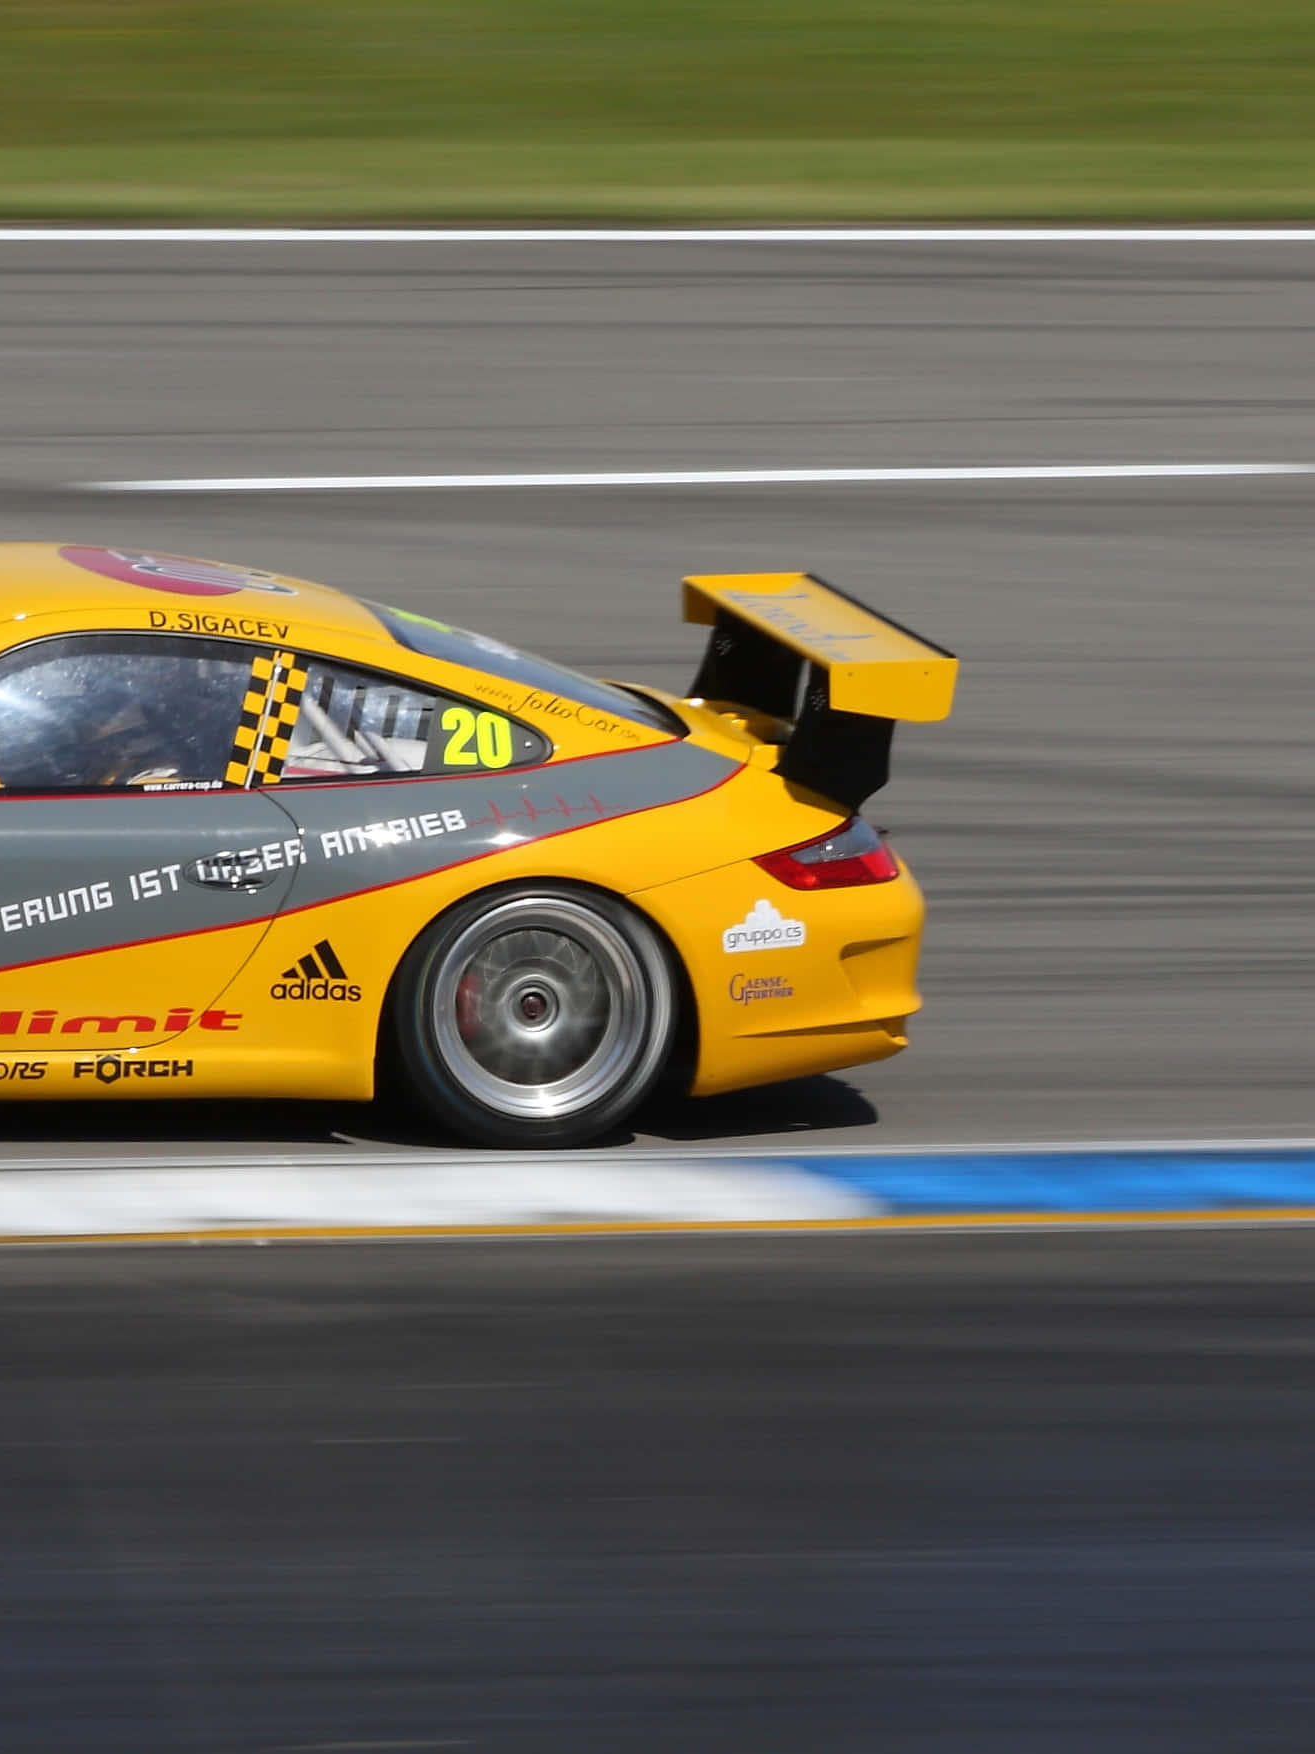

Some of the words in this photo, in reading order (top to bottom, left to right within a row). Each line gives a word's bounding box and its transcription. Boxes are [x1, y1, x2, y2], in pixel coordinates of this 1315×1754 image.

[441, 707, 513, 769] 20
[129, 863, 182, 901] IST
[727, 927, 783, 949] gruppo
[270, 978, 362, 1003] adidas
